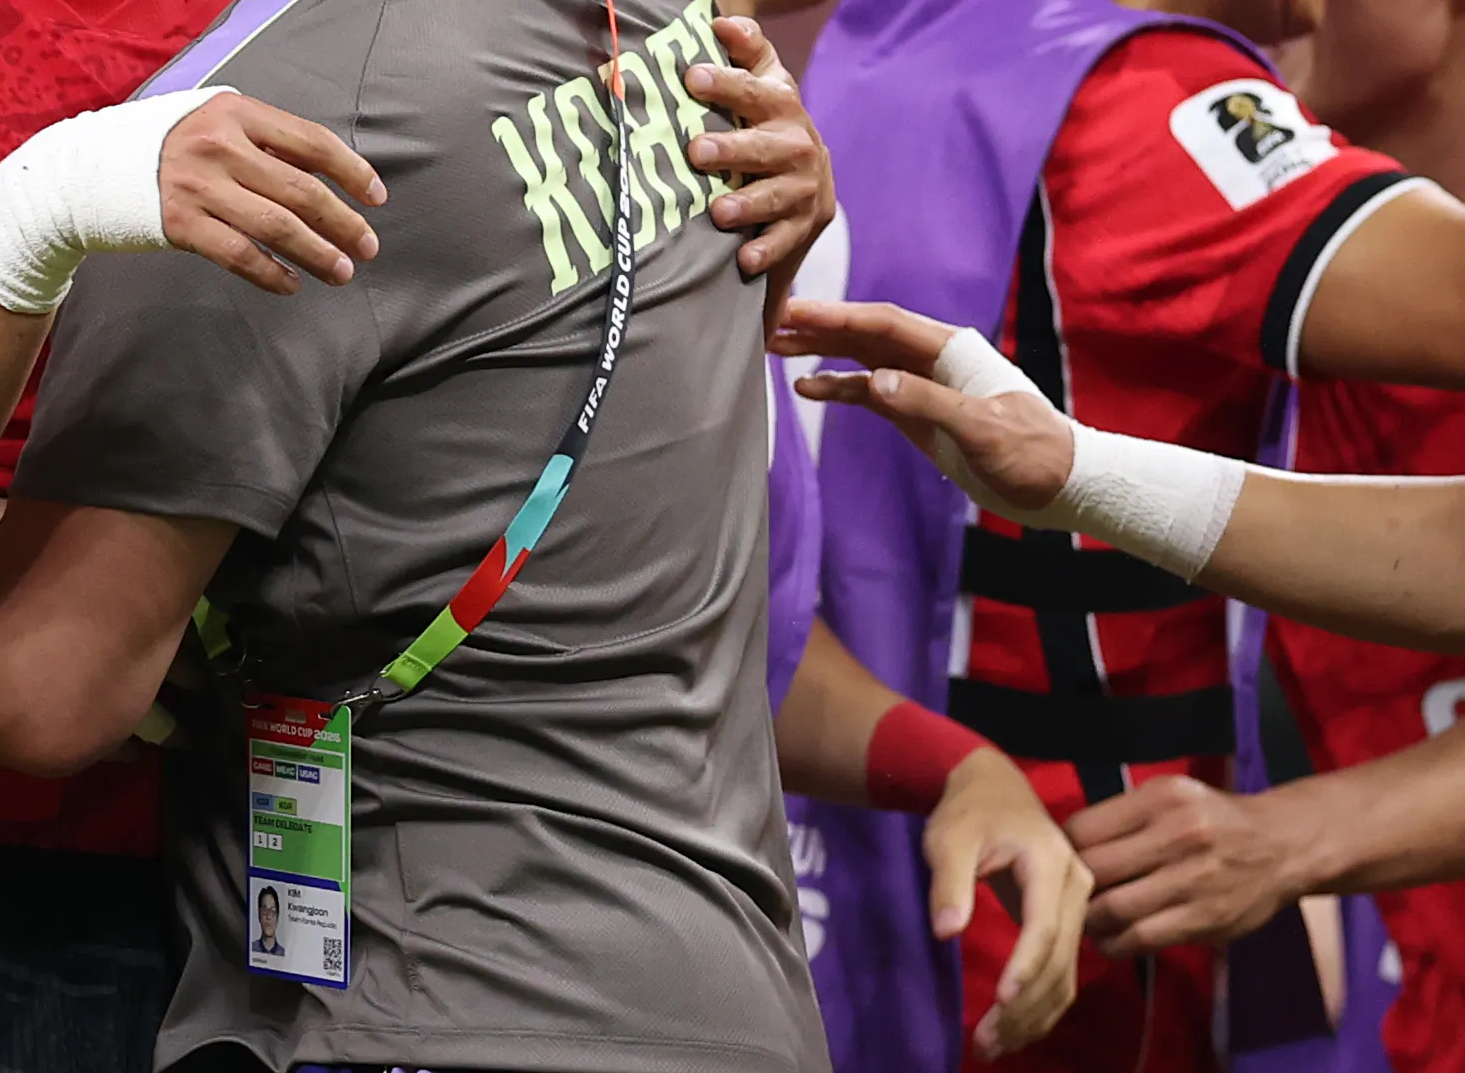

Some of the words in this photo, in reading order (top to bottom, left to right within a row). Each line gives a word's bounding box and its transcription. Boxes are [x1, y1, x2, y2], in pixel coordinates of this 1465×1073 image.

[577, 376, 608, 434] FIFA
[601, 273, 631, 372] WORLD
[617, 217, 632, 274] CUP
[270, 722, 297, 736] WORLD
[297, 727, 313, 738] CUP
[254, 815, 275, 826] TEAM
[287, 888, 301, 898] KIM
